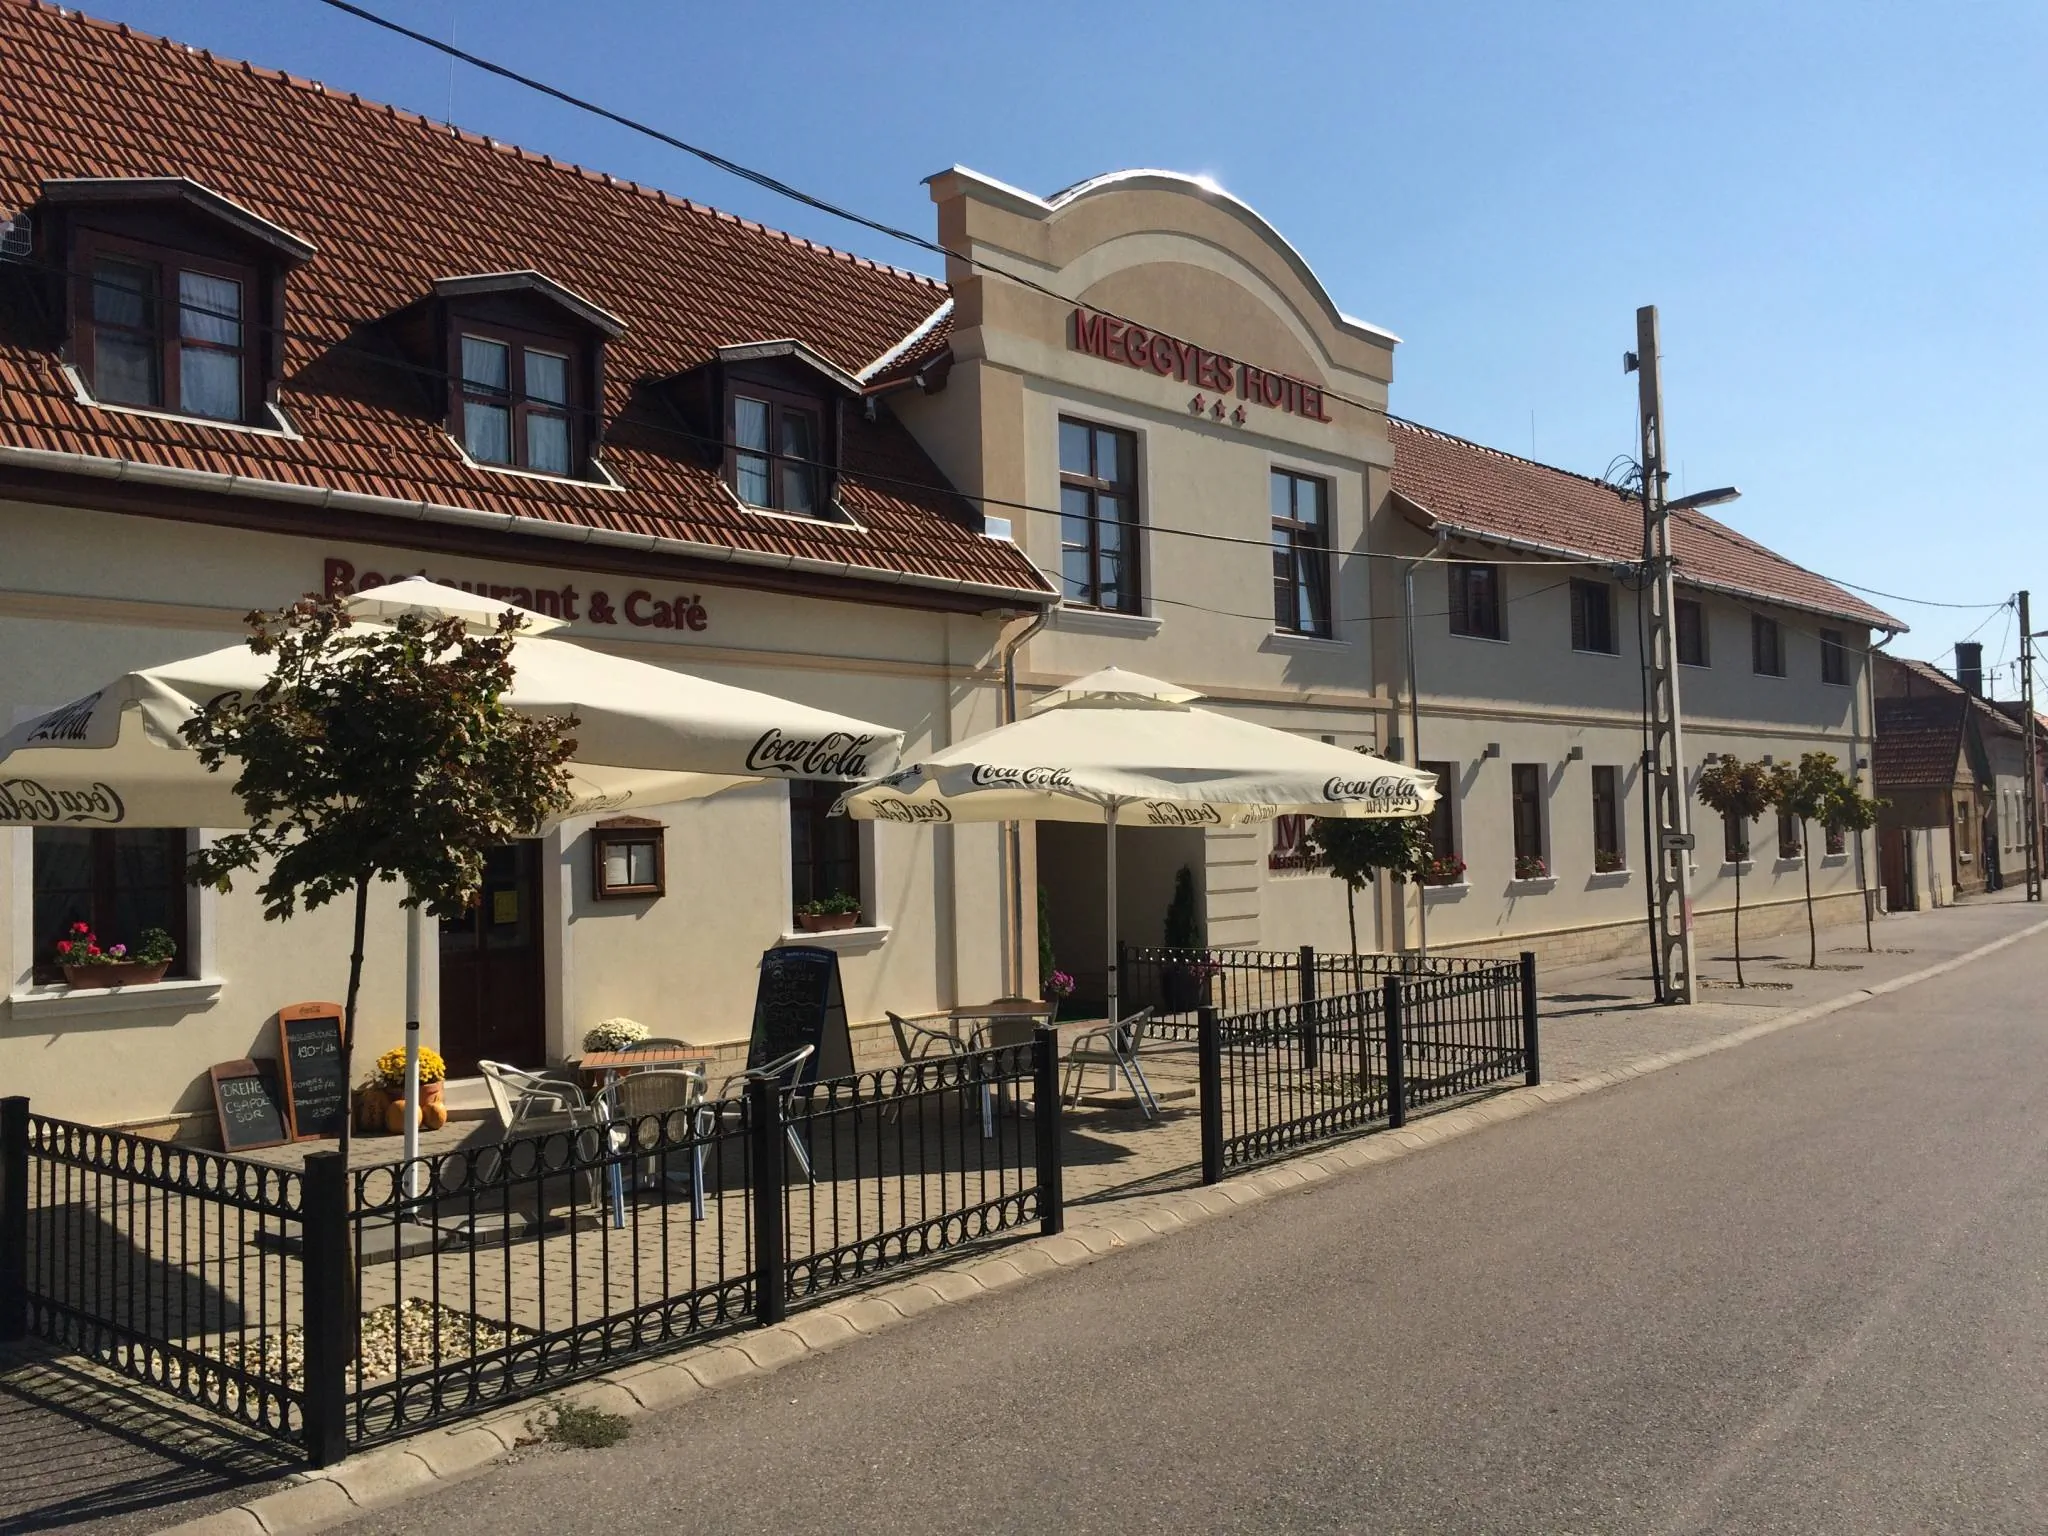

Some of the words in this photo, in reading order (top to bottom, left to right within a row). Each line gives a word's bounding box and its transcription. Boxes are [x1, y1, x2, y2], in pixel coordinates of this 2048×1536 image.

[1074, 308, 1235, 395] MEGGYES
[1243, 362, 1333, 424] HOTEL
[588, 590, 618, 626] &
[624, 588, 708, 632] Café
[745, 728, 875, 776] Coca-Cola
[971, 763, 1074, 787] Coca-Cola
[1323, 776, 1418, 801] Coca-Cola
[220, 1081, 264, 1097] DREHE
